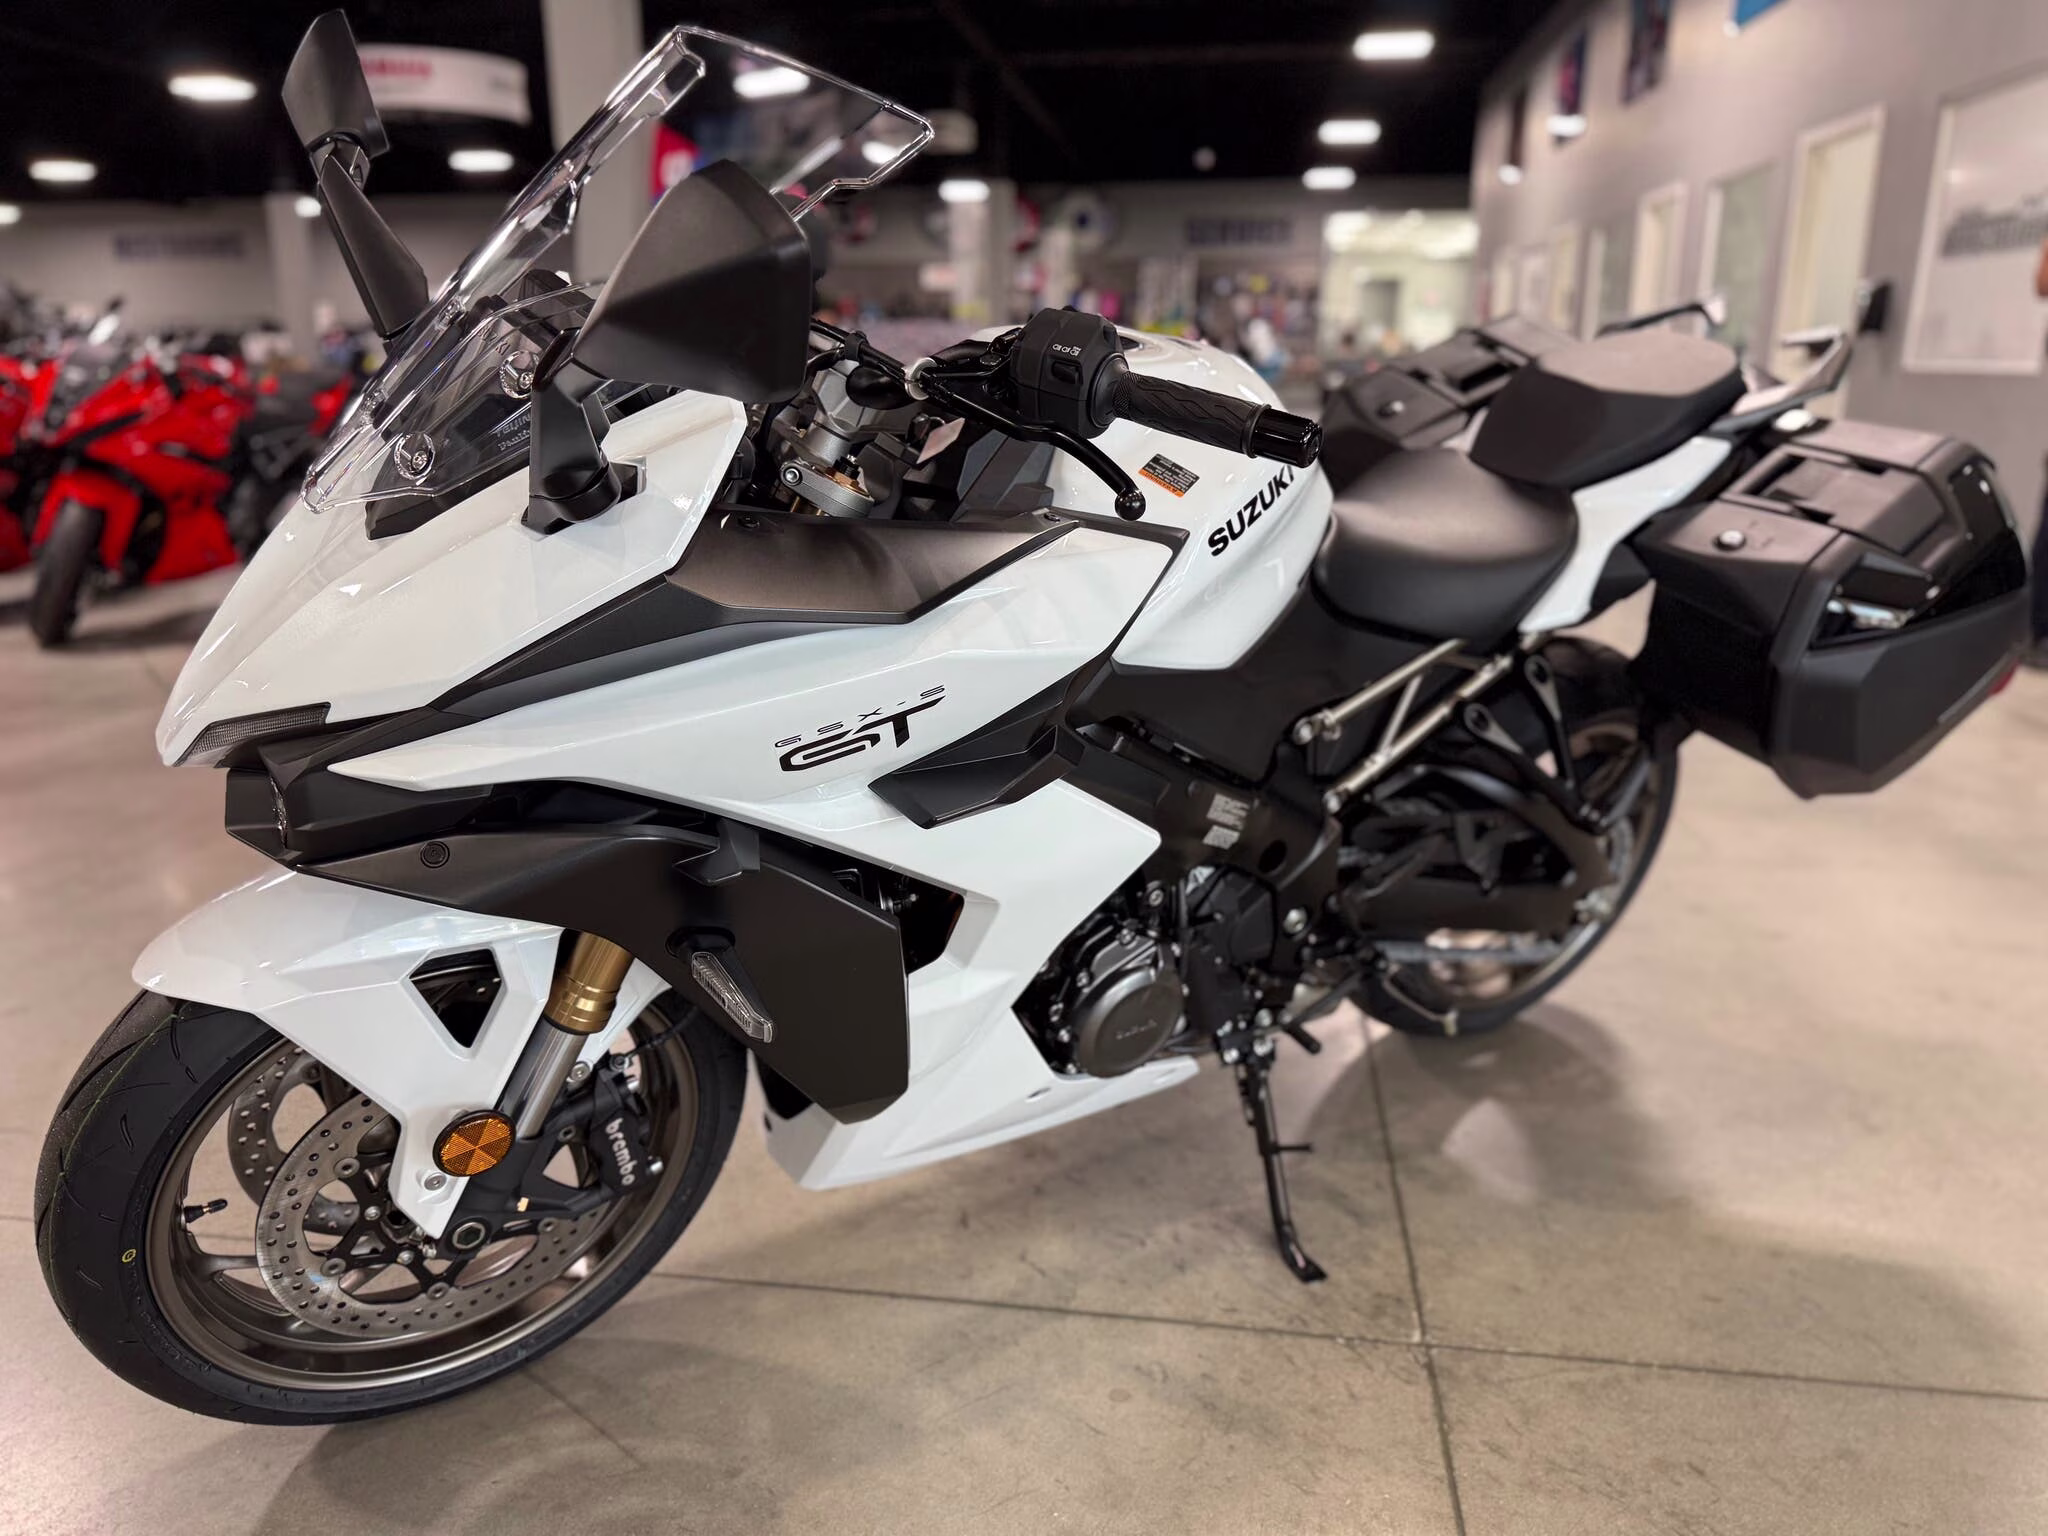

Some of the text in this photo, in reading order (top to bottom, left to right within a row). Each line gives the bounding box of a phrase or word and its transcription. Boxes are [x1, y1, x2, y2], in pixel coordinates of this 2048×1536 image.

[1208, 465, 1294, 556] SUZUKI
[775, 685, 945, 747] GSX-S
[779, 696, 946, 771] GT
[605, 1117, 637, 1186] brembo
